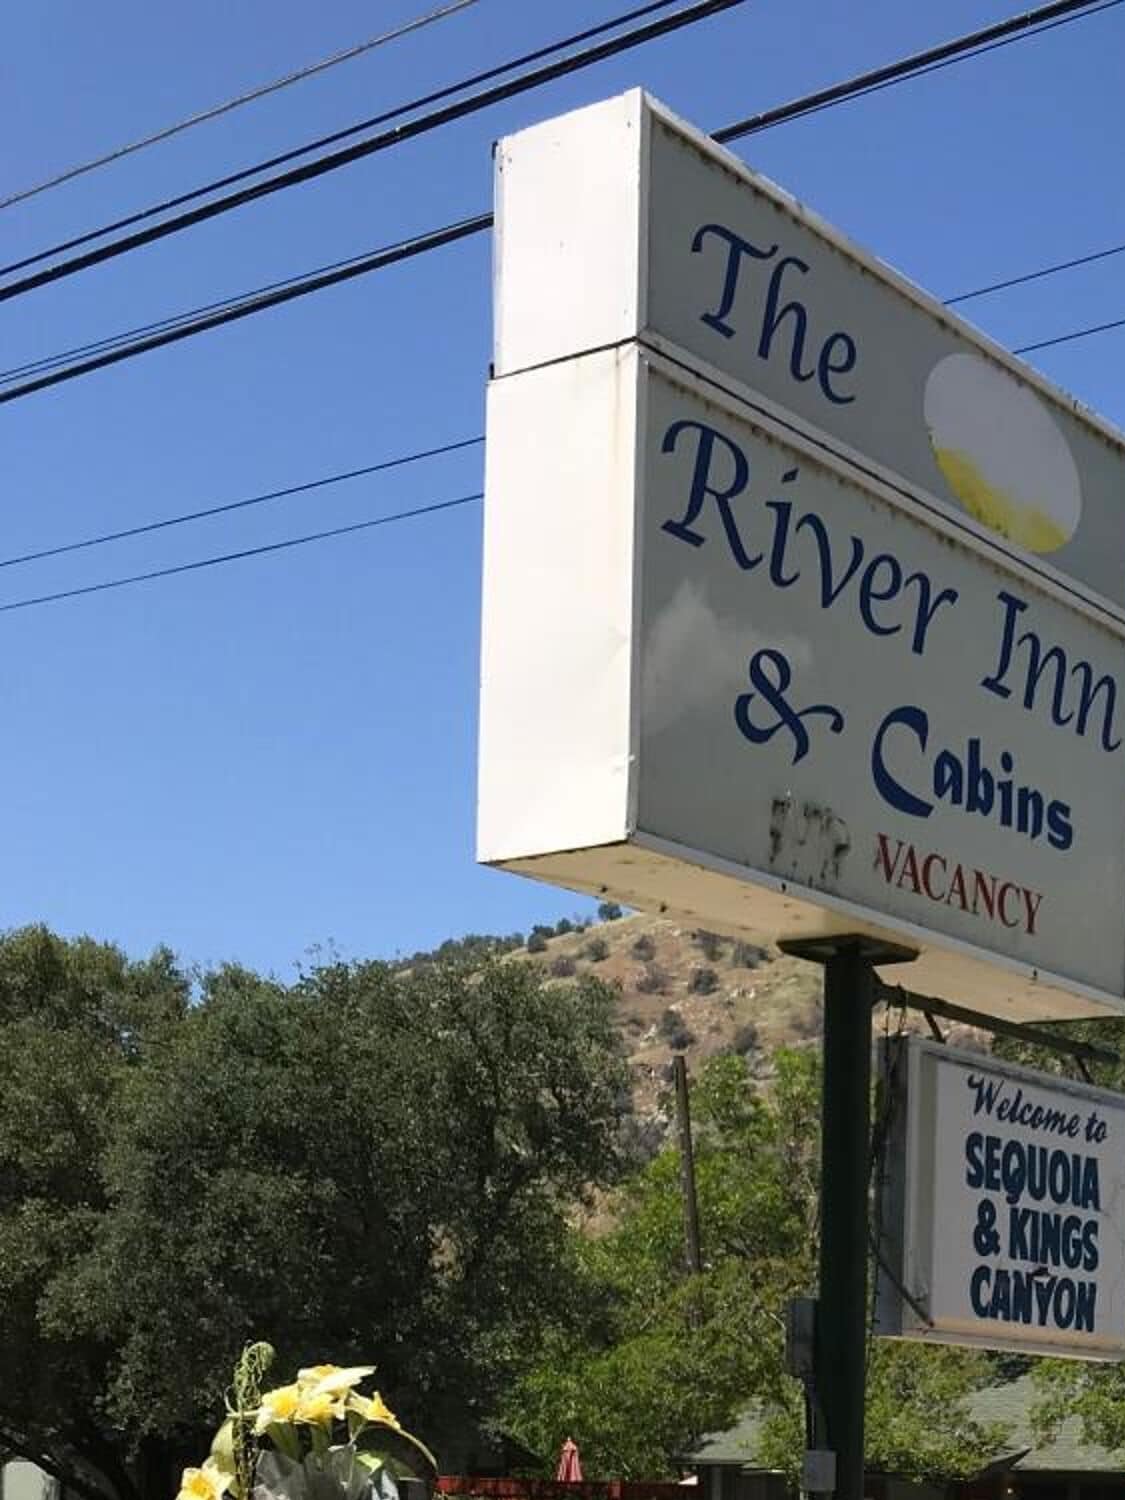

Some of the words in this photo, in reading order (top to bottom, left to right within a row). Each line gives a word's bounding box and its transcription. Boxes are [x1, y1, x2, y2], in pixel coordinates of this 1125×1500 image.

[690, 224, 857, 405] The
[660, 419, 960, 657] River
[979, 590, 1122, 752] Inn
[734, 648, 844, 766] &
[871, 704, 1073, 851] Cabins
[874, 833, 1043, 934] VACANCY
[967, 1075, 1079, 1138] Welcome
[1085, 1111, 1108, 1144] to
[965, 1131, 1101, 1212] SEQUOIA
[973, 1198, 1000, 1257] &
[1009, 1206, 1099, 1272] KINGS
[969, 1265, 1097, 1333] CANYON
